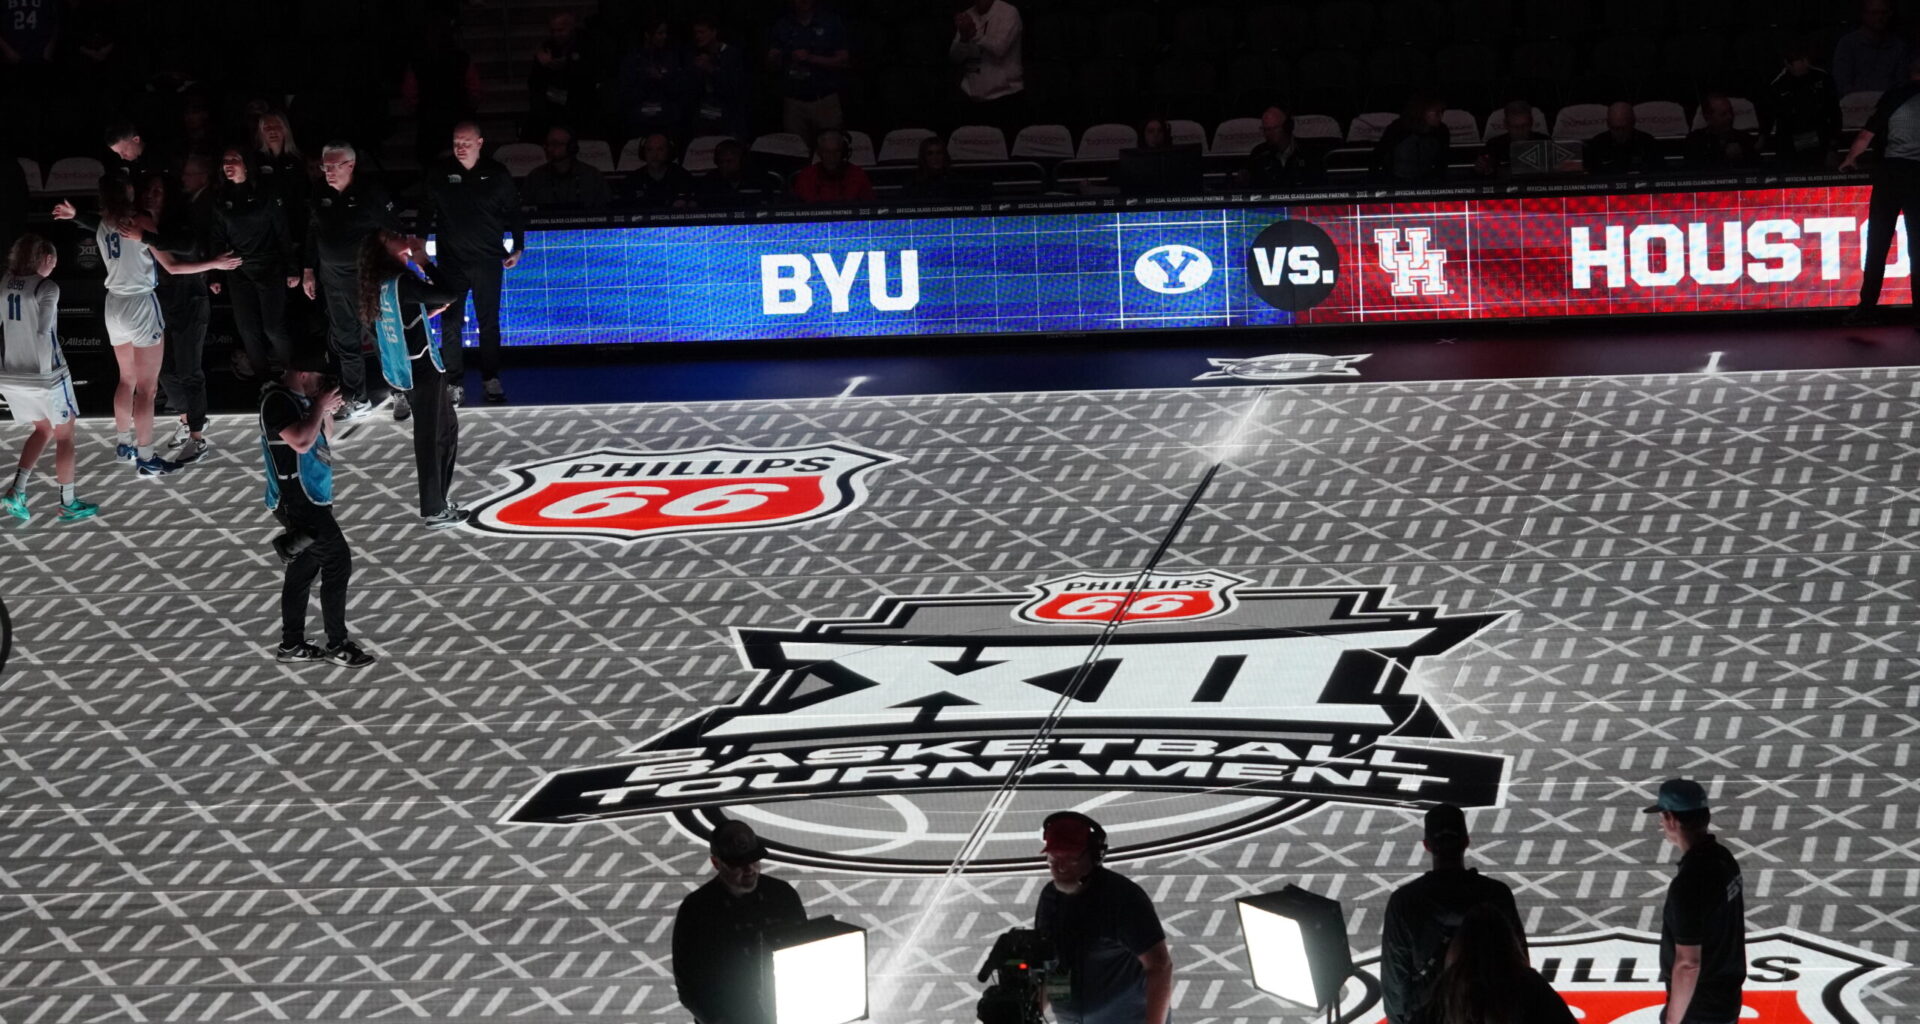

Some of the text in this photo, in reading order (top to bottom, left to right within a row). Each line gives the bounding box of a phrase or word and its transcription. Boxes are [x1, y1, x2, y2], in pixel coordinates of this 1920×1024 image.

[14, 10, 38, 30] 24
[105, 232, 121, 259] 13
[1252, 245, 1335, 287] VS.
[760, 249, 920, 315] BYU
[7, 293, 21, 321] 11
[64, 336, 102, 346] Allstate
[561, 456, 837, 479] PHILLIPS
[537, 482, 790, 520] 66
[1063, 578, 1216, 592] PHILLIPS
[1057, 594, 1194, 616] 66
[701, 627, 1439, 737] XII
[624, 737, 1430, 783] BASKETBALL
[580, 758, 1450, 806] TOURNAMENT
